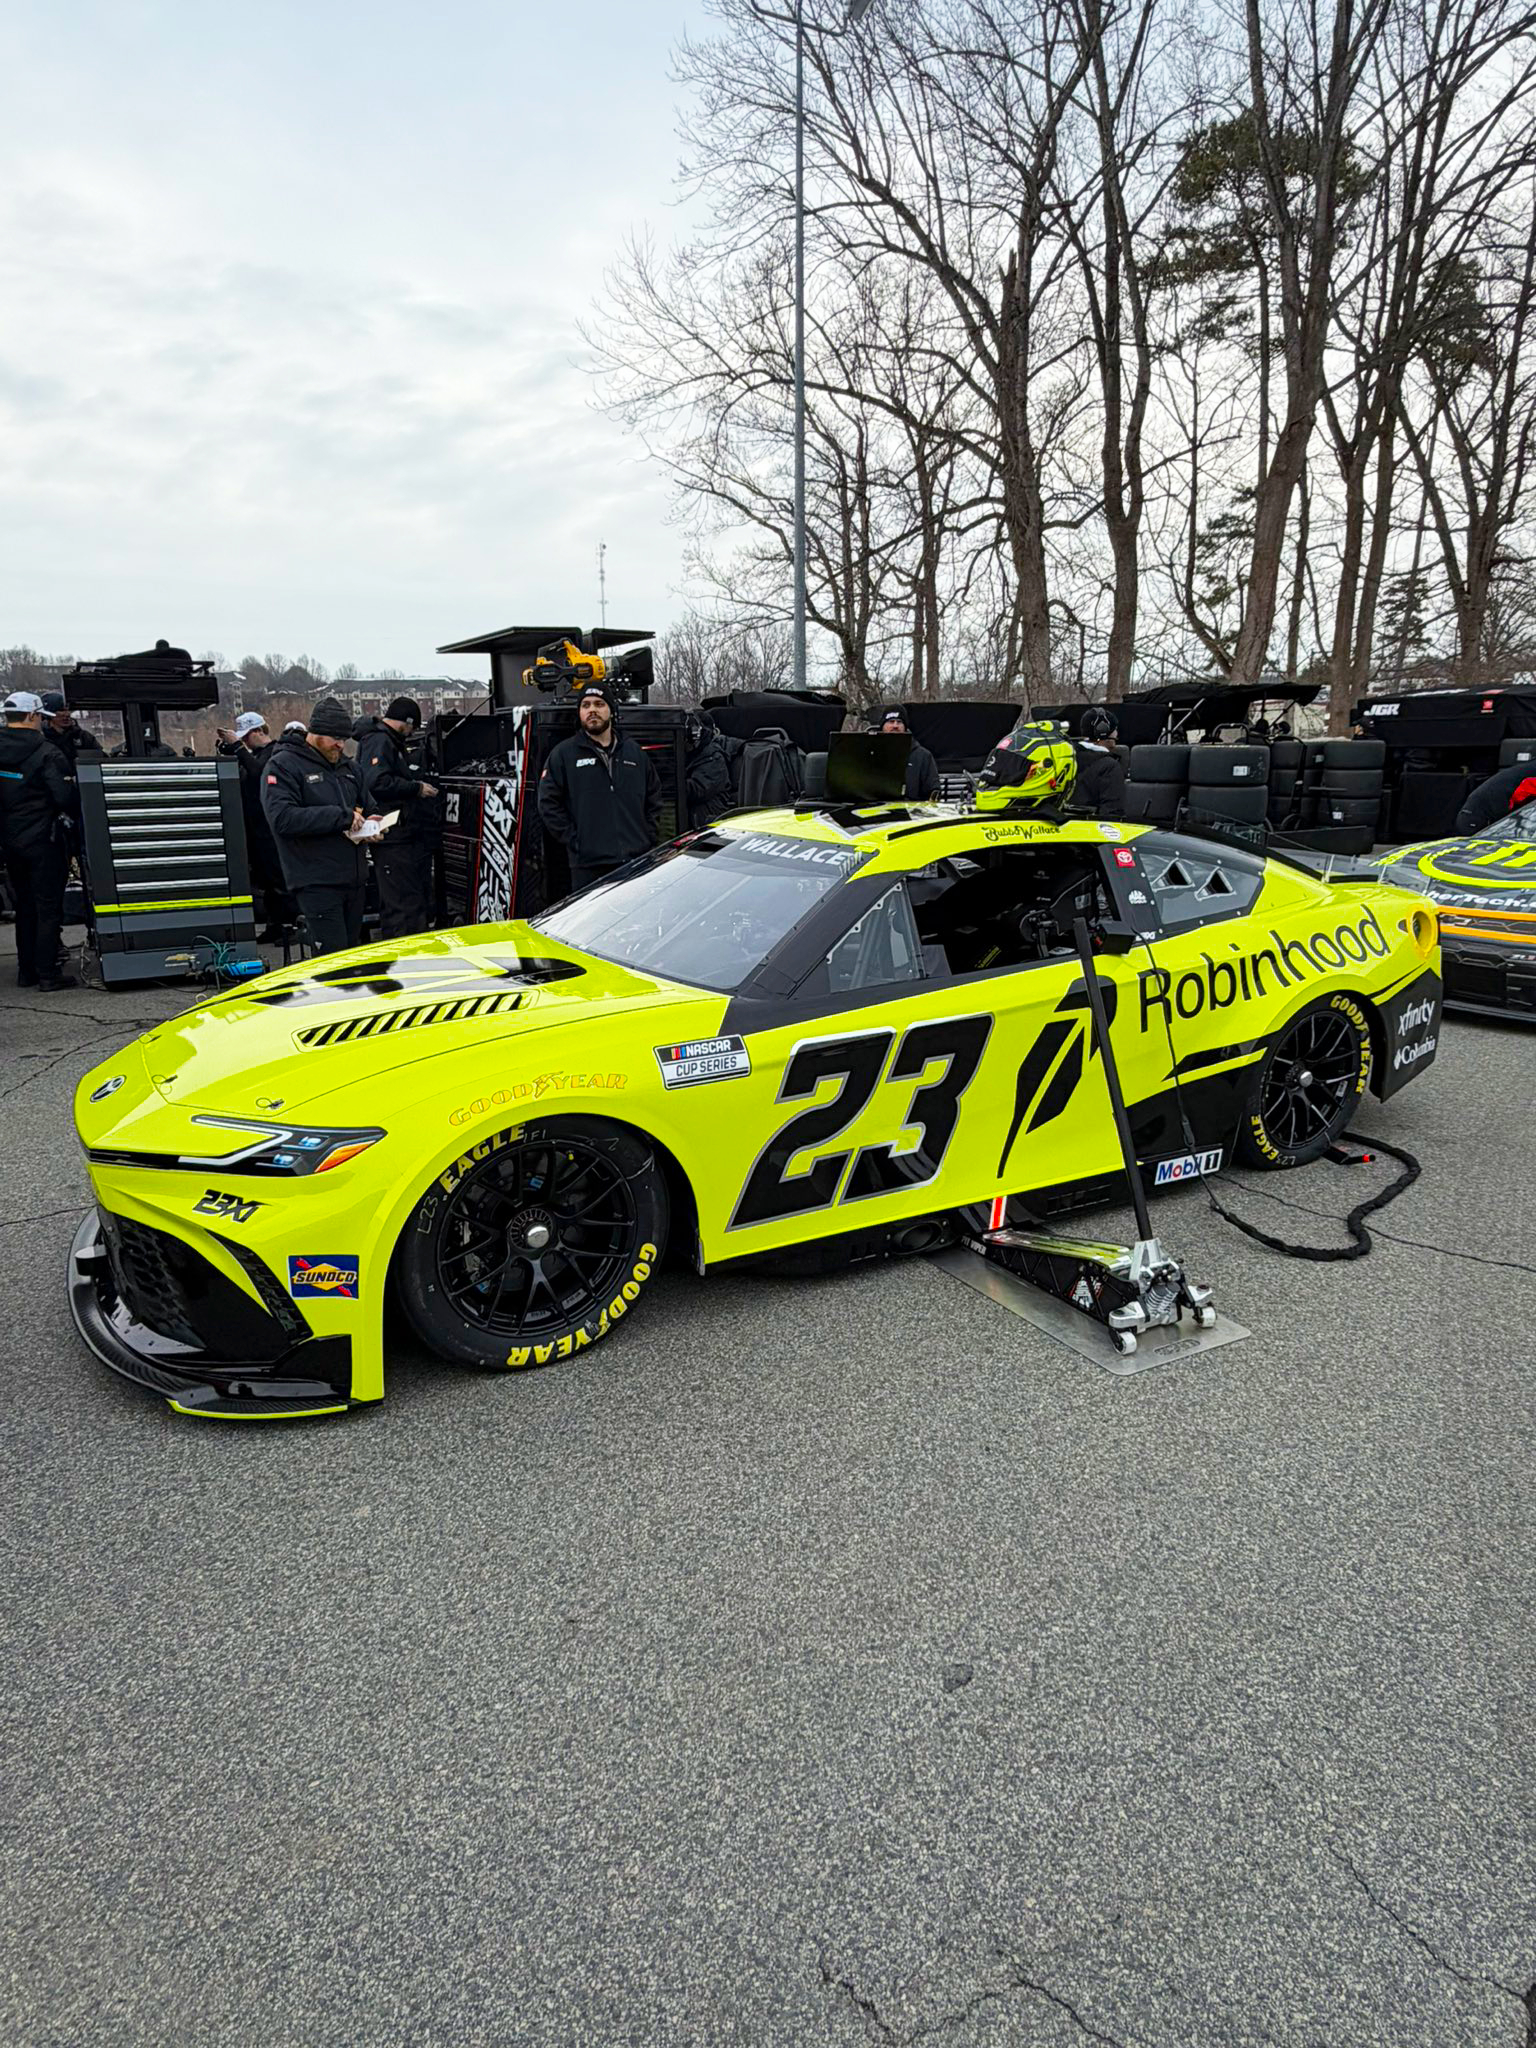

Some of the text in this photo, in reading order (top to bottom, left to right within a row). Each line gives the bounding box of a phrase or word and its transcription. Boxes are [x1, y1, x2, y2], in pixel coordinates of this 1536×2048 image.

[1363, 703, 1400, 716] JGR
[446, 792, 460, 823] 23
[981, 824, 1061, 842] Bubba Wallace
[739, 838, 855, 866] WALLACE
[1137, 904, 1391, 1033] Robinhood
[1397, 998, 1436, 1036] xfinity
[686, 1040, 731, 1057] NASCAR
[1401, 1035, 1436, 1065] Columbia
[676, 1056, 737, 1077] CUP SERIES
[448, 1071, 629, 1127] GOODYEAR
[724, 1011, 996, 1233] 23
[1250, 1114, 1280, 1161] EAGLE
[439, 1123, 528, 1195] EAGLE
[969, 1238, 988, 1256] VIPER
[295, 1271, 357, 1284] SUNOCO
[506, 1242, 658, 1367] GOODYEAR
